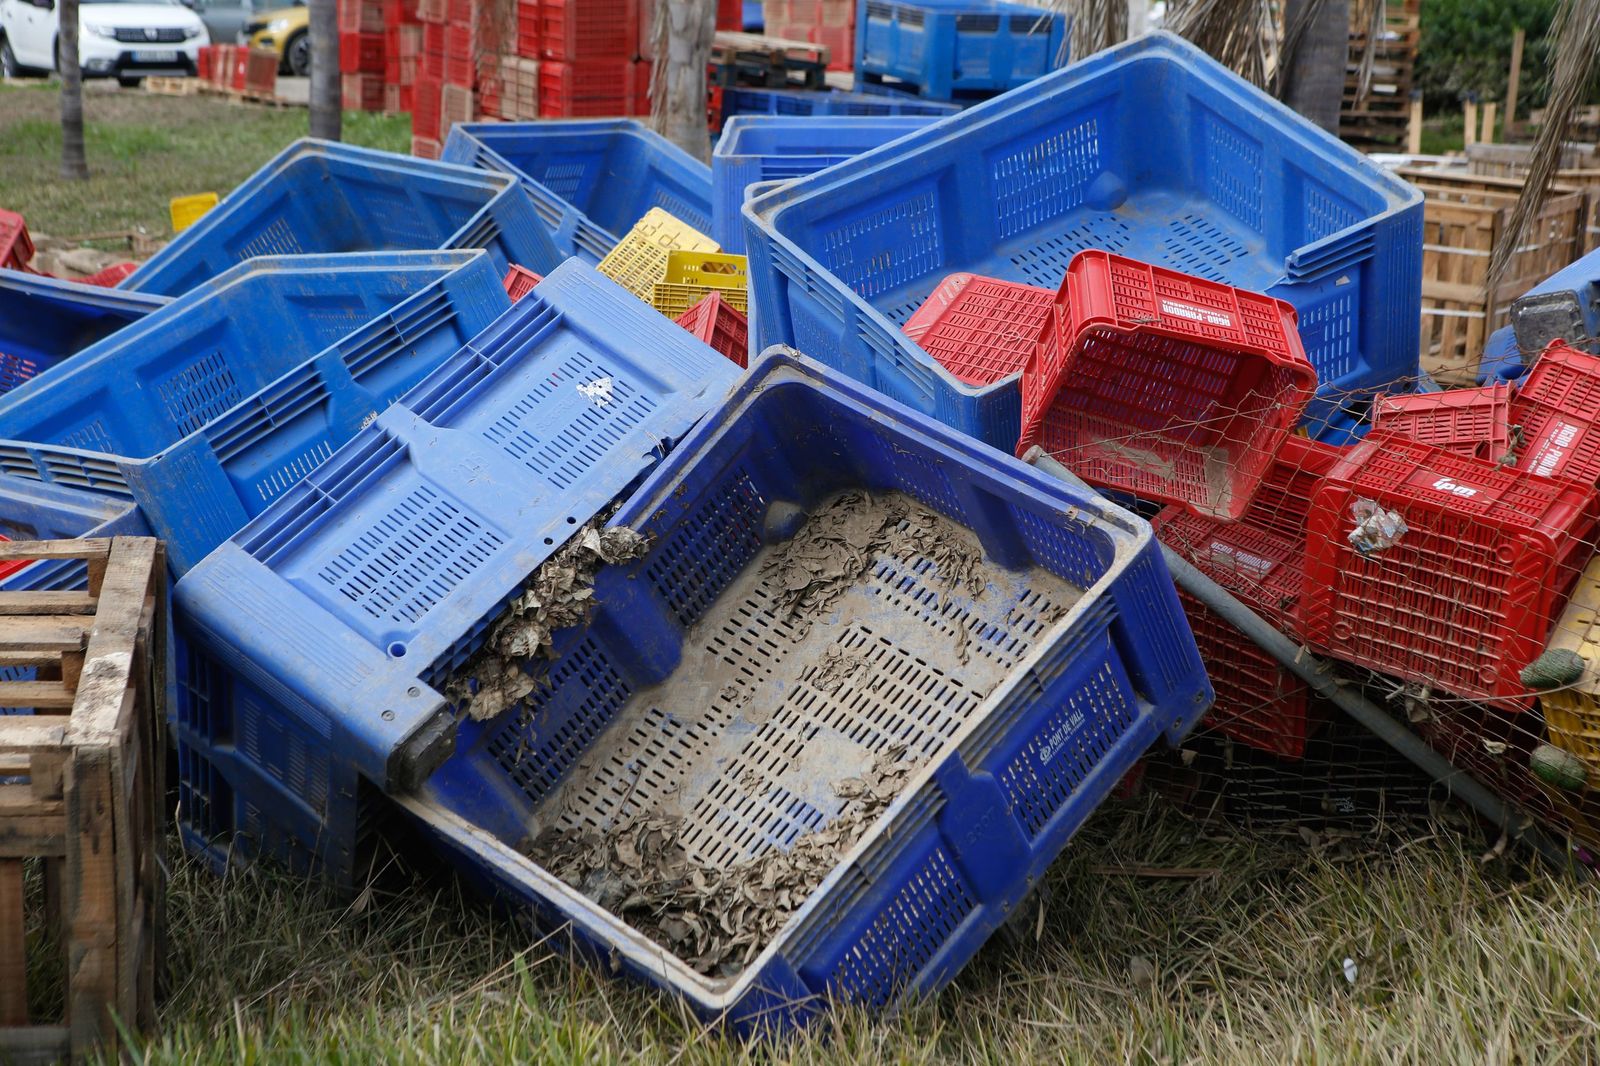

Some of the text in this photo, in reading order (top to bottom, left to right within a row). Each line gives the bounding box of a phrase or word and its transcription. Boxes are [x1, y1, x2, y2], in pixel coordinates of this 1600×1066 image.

[1162, 303, 1231, 327] AGRO-PARADOR
[1049, 728, 1063, 750] PONT
[1062, 720, 1071, 735] DE
